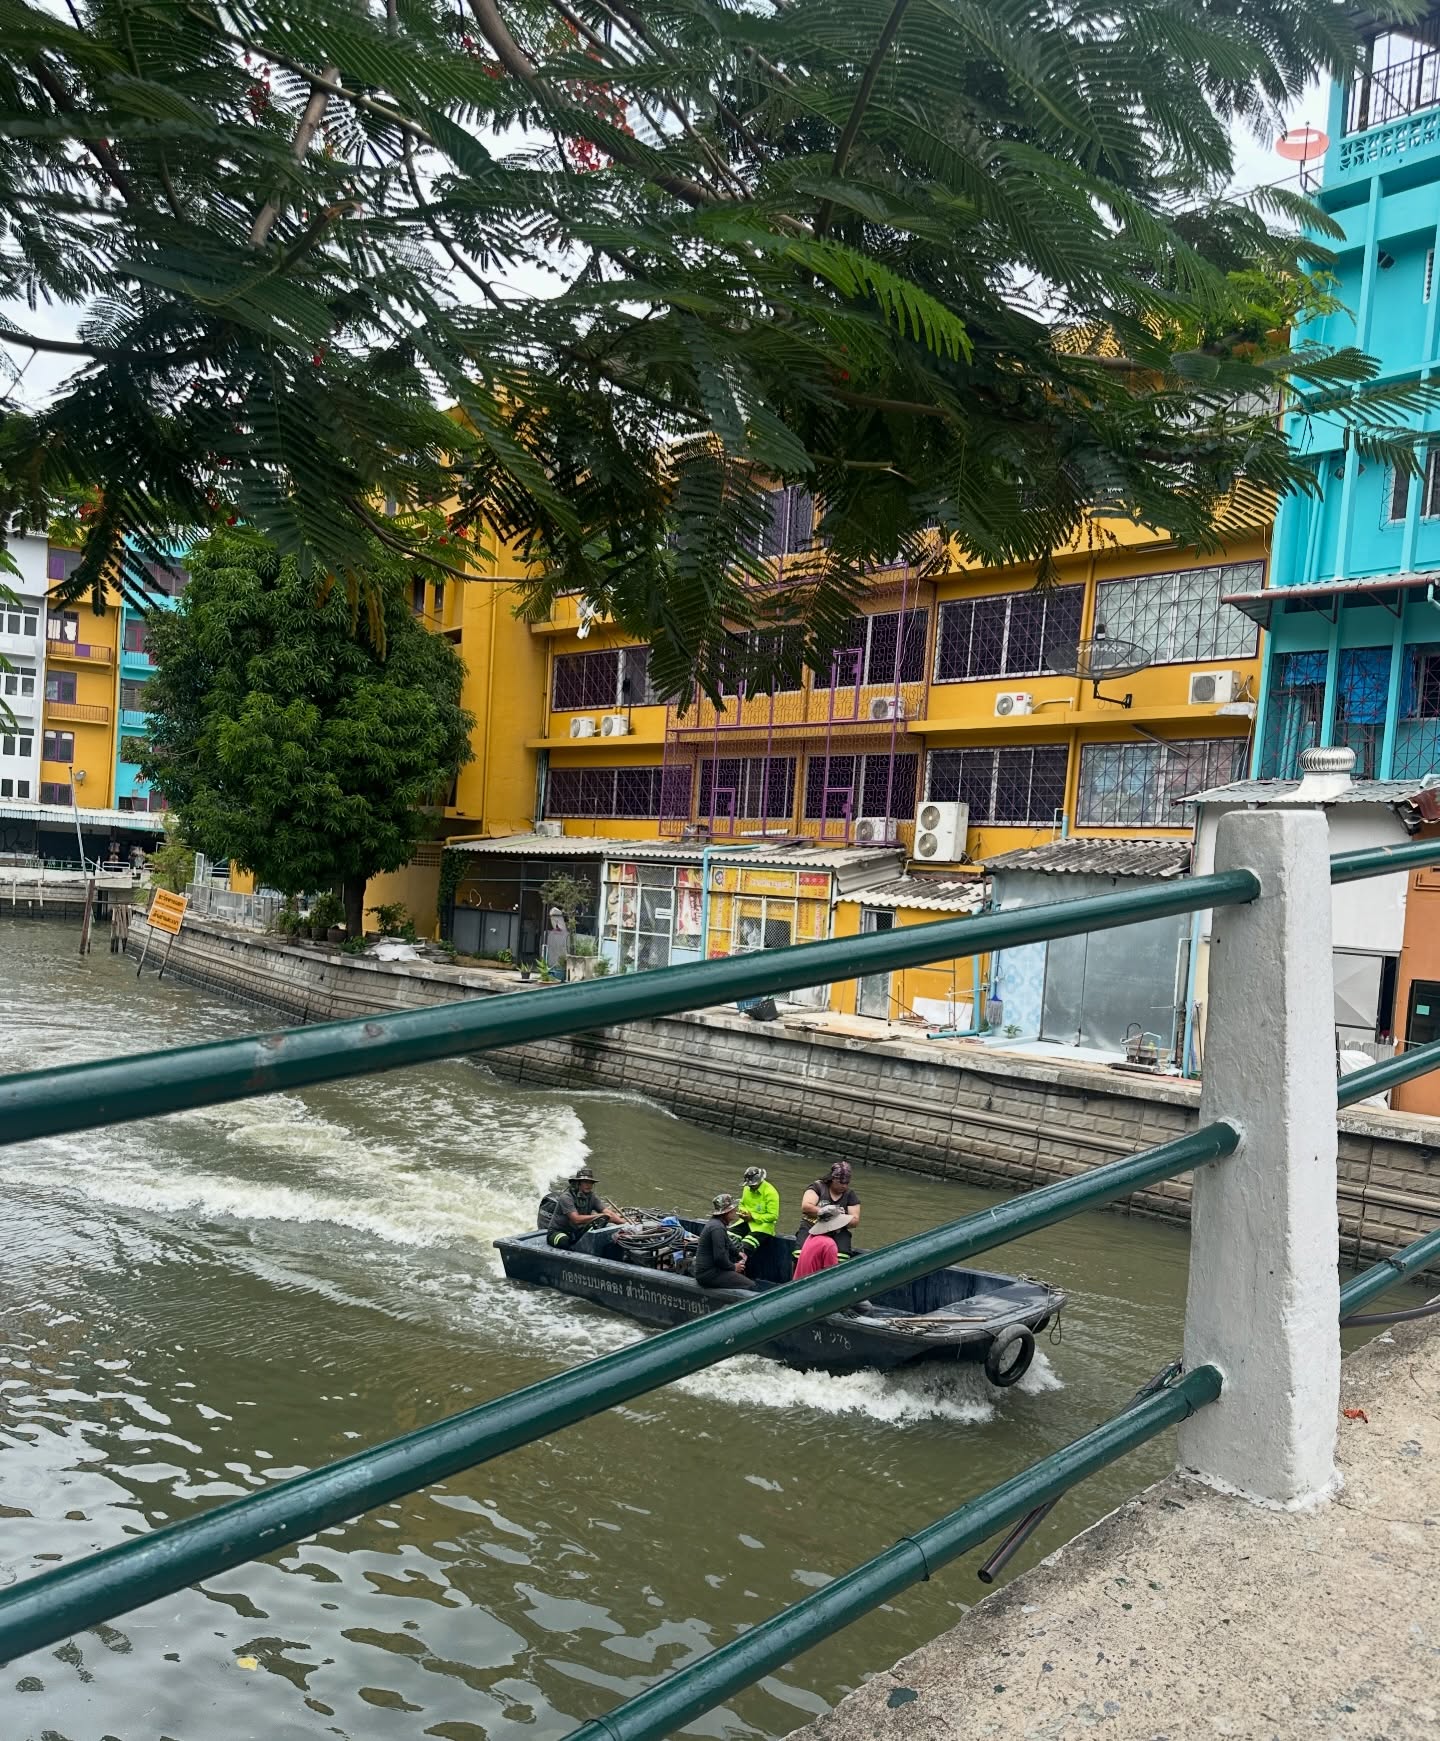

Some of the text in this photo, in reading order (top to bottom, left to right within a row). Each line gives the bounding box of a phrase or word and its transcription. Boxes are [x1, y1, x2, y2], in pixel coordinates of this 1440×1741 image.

[562, 1270, 623, 1295] กองระบบคลอง
